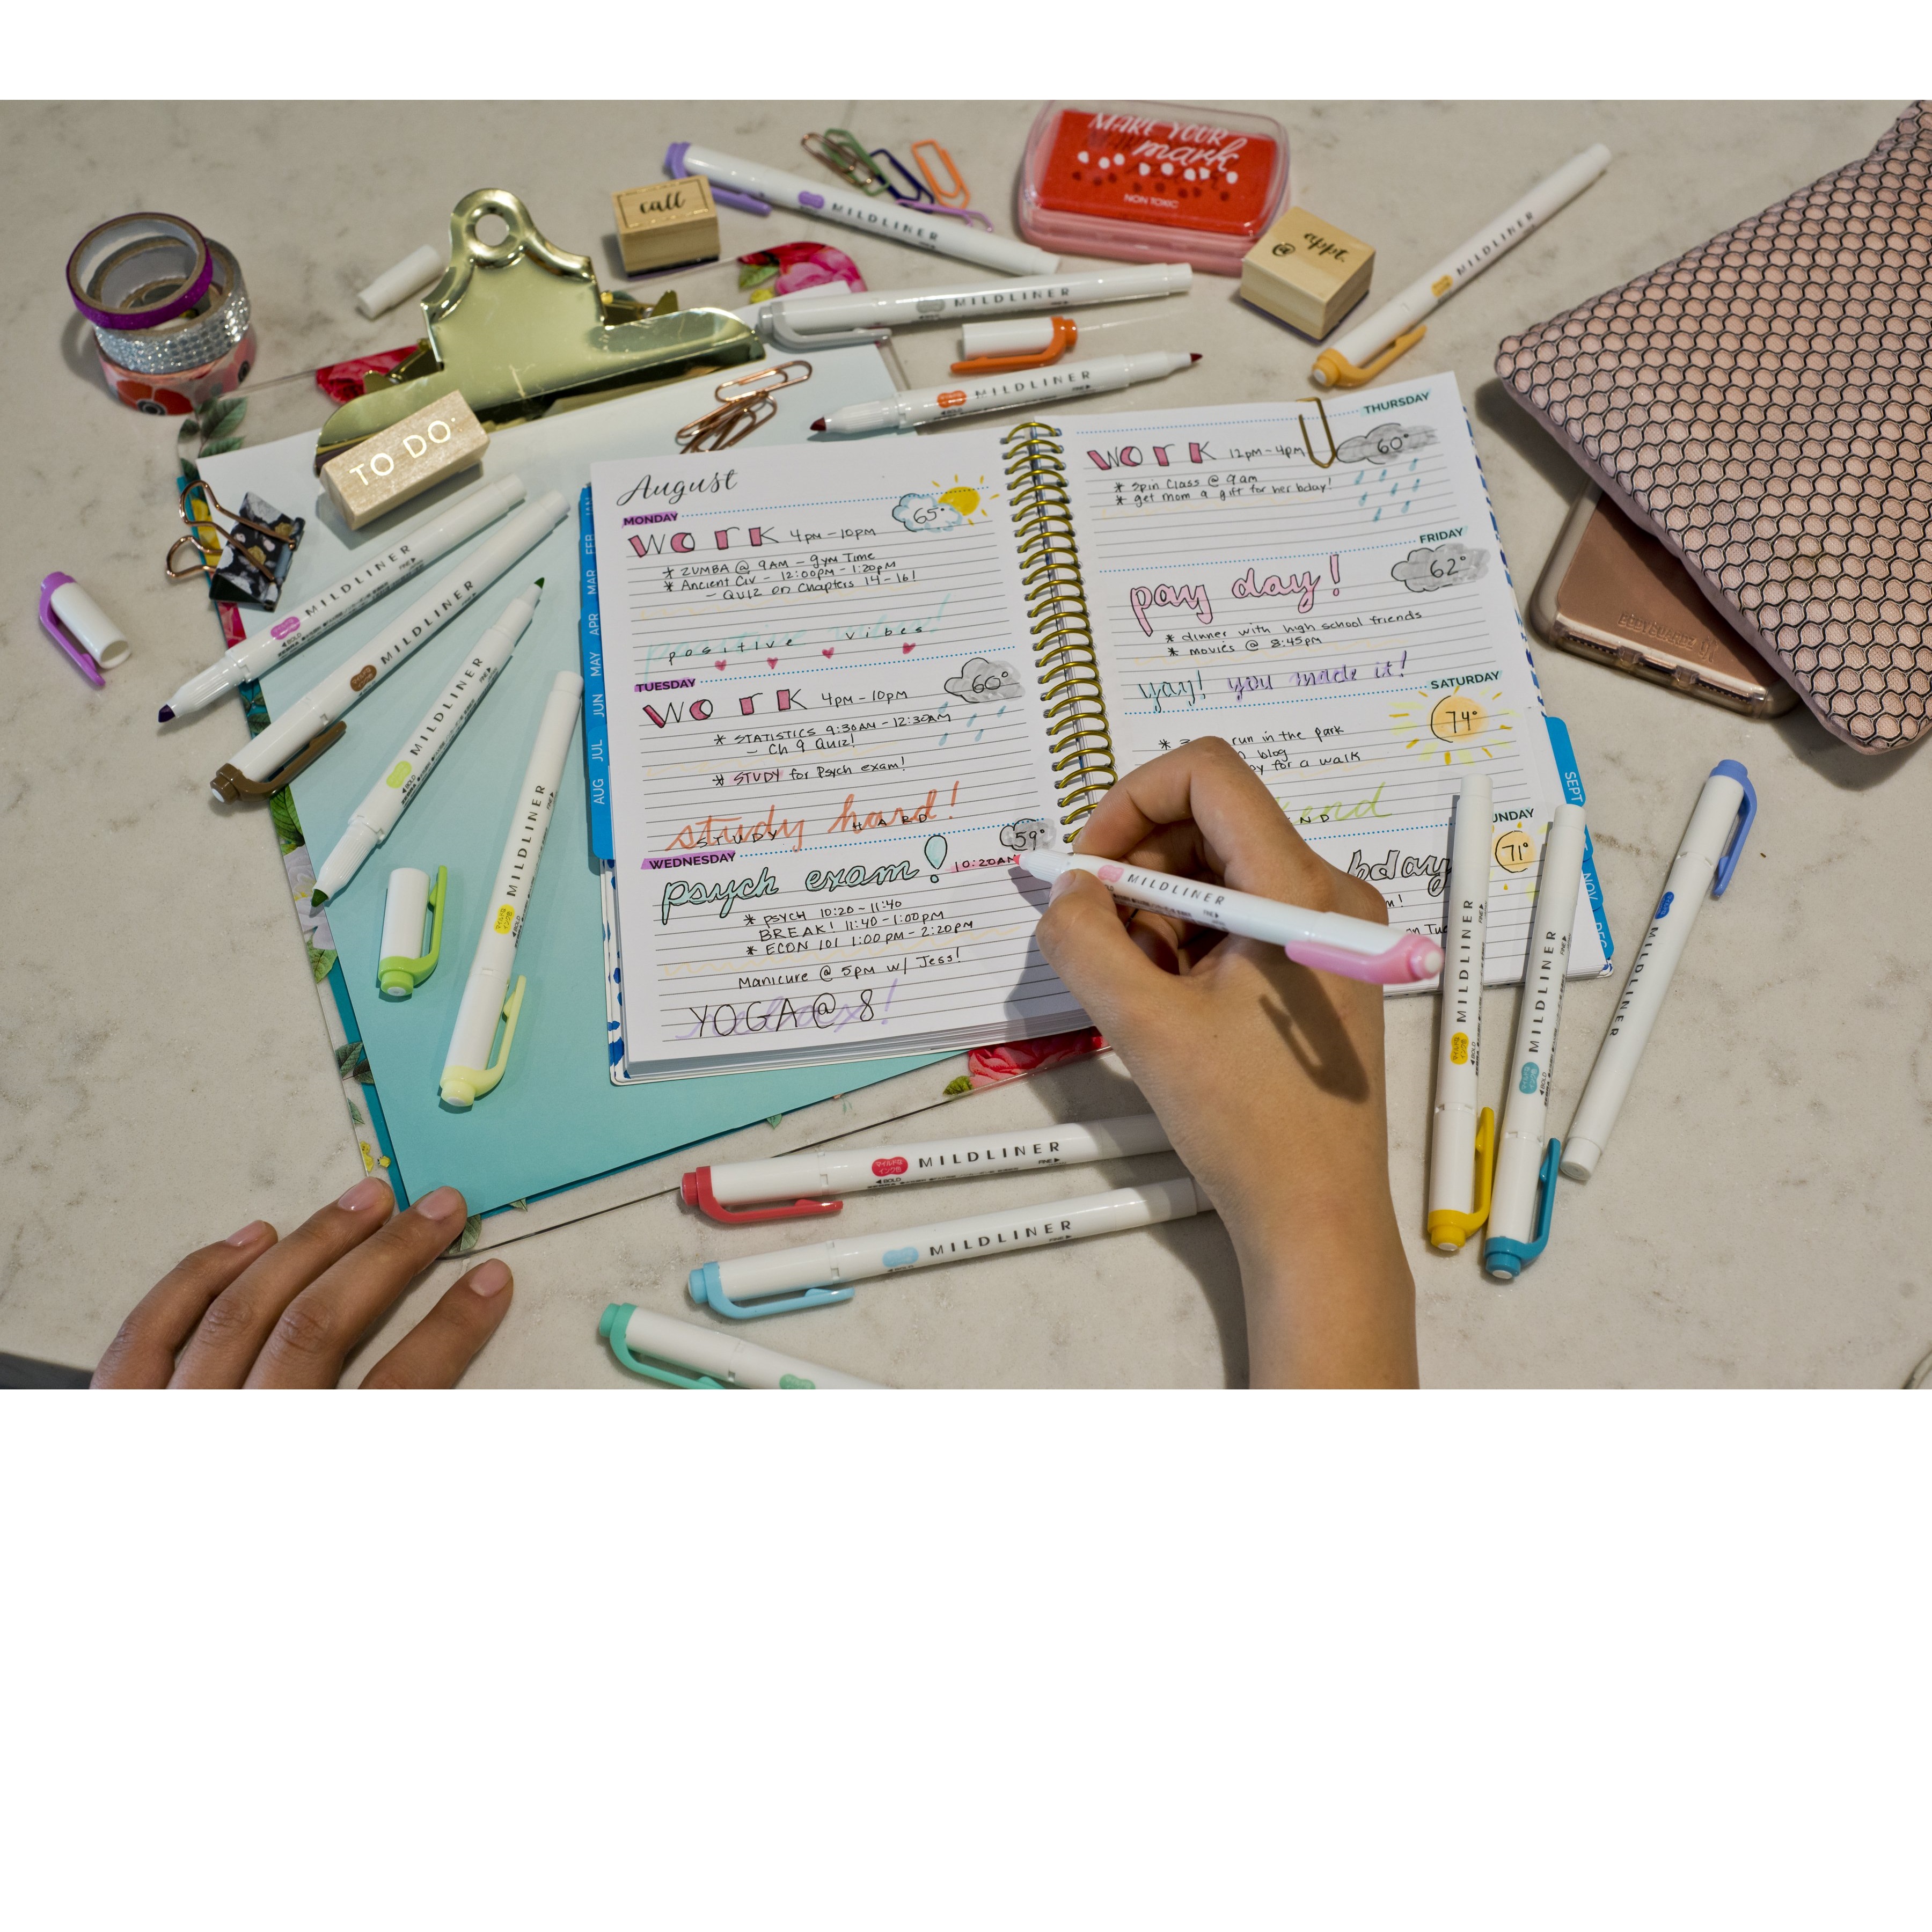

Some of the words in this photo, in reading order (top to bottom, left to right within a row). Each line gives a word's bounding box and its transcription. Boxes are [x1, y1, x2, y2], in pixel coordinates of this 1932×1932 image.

[1168, 121, 1229, 146] YOUR
[1131, 137, 1248, 172] mark
[640, 191, 686, 214] call
[1124, 193, 1148, 204] NON
[1150, 196, 1179, 209] TOXIC
[831, 202, 938, 240] MILDLINER
[954, 287, 1070, 308] MILDLINER
[974, 370, 1091, 399] MILDLINER
[1364, 391, 1430, 415] THURSDAY
[349, 453, 394, 486] TO
[617, 469, 738, 506] August
[1133, 492, 1155, 508] get
[1162, 492, 1191, 502] mom
[1219, 487, 1243, 501] gift
[1251, 484, 1265, 494] for
[1272, 483, 1290, 494] her
[623, 513, 678, 526] MONDAY
[1419, 528, 1465, 544] FRIDAY
[305, 544, 411, 617] MILDLINER
[586, 569, 598, 595] MAR
[680, 564, 730, 576] ZUMBA
[681, 577, 729, 591] Ancient
[797, 578, 854, 593] Chapters
[1130, 583, 1213, 637] pay
[380, 580, 474, 665] MILDLINER
[589, 613, 600, 636] APR
[846, 626, 923, 640] vibes
[1182, 630, 1227, 642] dinner
[1238, 623, 1271, 636] with
[1283, 619, 1316, 633] high
[1321, 617, 1364, 631] school
[1370, 610, 1423, 626] friends
[668, 638, 794, 666] positive
[1189, 641, 1235, 656] movies
[589, 652, 602, 676] MAY
[479, 672, 489, 683] FINE
[636, 678, 696, 693] TUESDAY
[1227, 675, 1274, 702] you
[1289, 664, 1357, 686] made
[1431, 671, 1500, 690] SATURDAY
[409, 657, 484, 756] MILDLINER
[592, 694, 605, 718] JUN
[734, 728, 817, 744] STATISTICS
[1232, 735, 1254, 745] run
[1262, 731, 1275, 742] in
[1278, 730, 1306, 741] the
[1314, 726, 1344, 743] park
[591, 739, 604, 762] JUL
[1257, 749, 1289, 762] blog
[1271, 759, 1292, 771] for
[1319, 752, 1361, 766] walk
[404, 774, 416, 789] BOLD
[733, 768, 780, 785] STUDY
[789, 768, 809, 780] for
[816, 766, 852, 779] Psych
[861, 756, 906, 772] exam!
[401, 784, 418, 805] ZEBRA
[592, 779, 605, 804] AUG
[1565, 771, 1583, 802] SEPT
[1493, 808, 1535, 823] UNDAY
[664, 804, 806, 853] study
[696, 829, 778, 848] STUDY
[852, 814, 928, 830] HARD
[506, 785, 546, 897] MILDLINER
[649, 853, 736, 870] WEDNESDAY
[661, 867, 779, 926] psych
[1127, 873, 1226, 906] MILDLINER
[1582, 872, 1598, 901] NOV
[495, 907, 507, 930] マイルドな
[503, 910, 513, 930] インク色
[513, 915, 521, 932] BOLD
[759, 921, 836, 942] BREAK!
[766, 940, 808, 955] ECON
[738, 971, 809, 989] Manicure
[916, 947, 961, 968] Jess!
[1457, 900, 1474, 1023] MILDLINER
[1528, 931, 1556, 1053] MILDLINER
[1609, 926, 1659, 1036] MILDLINER
[689, 998, 799, 1038] YOGA
[812, 992, 837, 1029] @
[859, 988, 875, 1022] 8
[875, 1158, 904, 1168] マイルドな
[918, 1141, 1060, 1168] MILDLINER
[878, 1166, 902, 1174] インク色
[883, 1176, 902, 1184] BOLD
[929, 1220, 1072, 1257] MILDLINER
